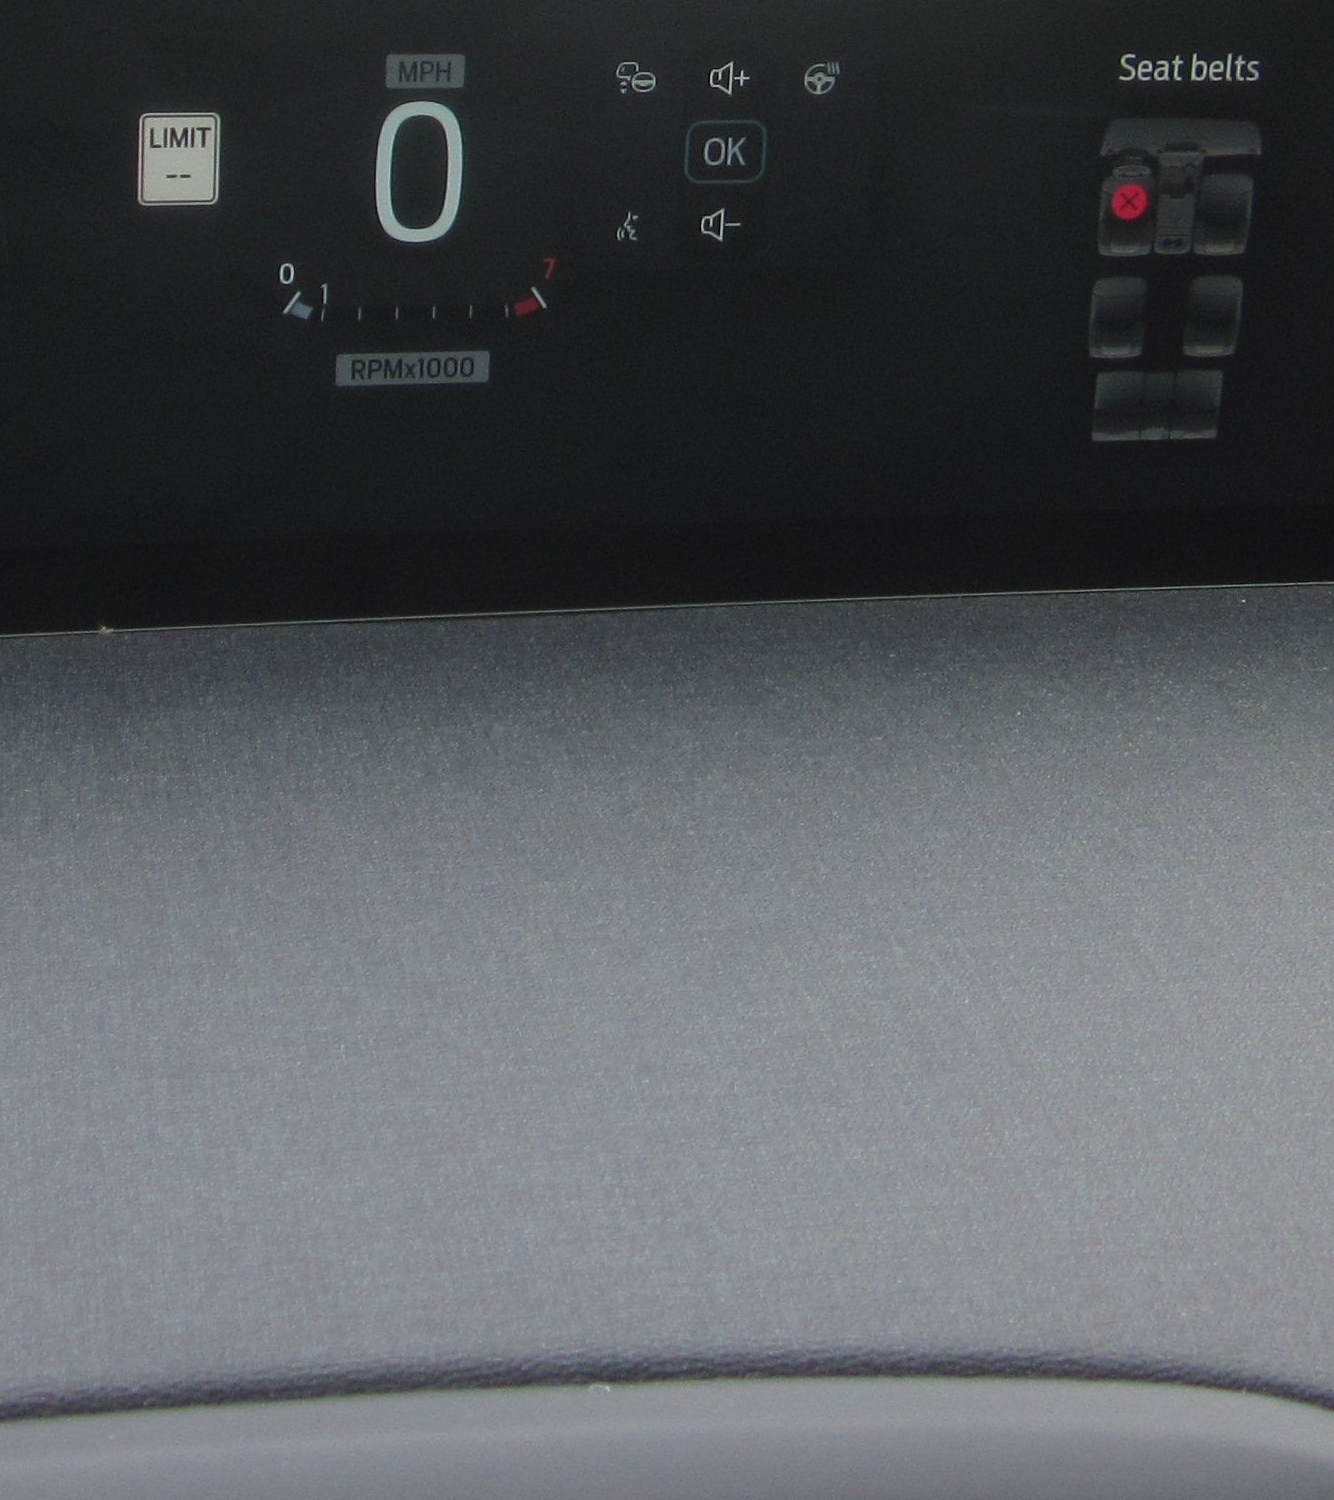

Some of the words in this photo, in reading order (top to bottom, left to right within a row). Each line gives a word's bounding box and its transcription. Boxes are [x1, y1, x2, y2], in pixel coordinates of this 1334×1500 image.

[396, 60, 454, 84] MPH
[1118, 53, 1184, 82] Seat
[1190, 52, 1260, 82] belts
[148, 126, 212, 150] LIMIT
[702, 136, 747, 167] OK
[374, 100, 464, 243] 0
[278, 262, 296, 285] 0
[541, 257, 557, 280] 7
[319, 283, 329, 304] 1
[349, 355, 476, 382] RPMx1000
